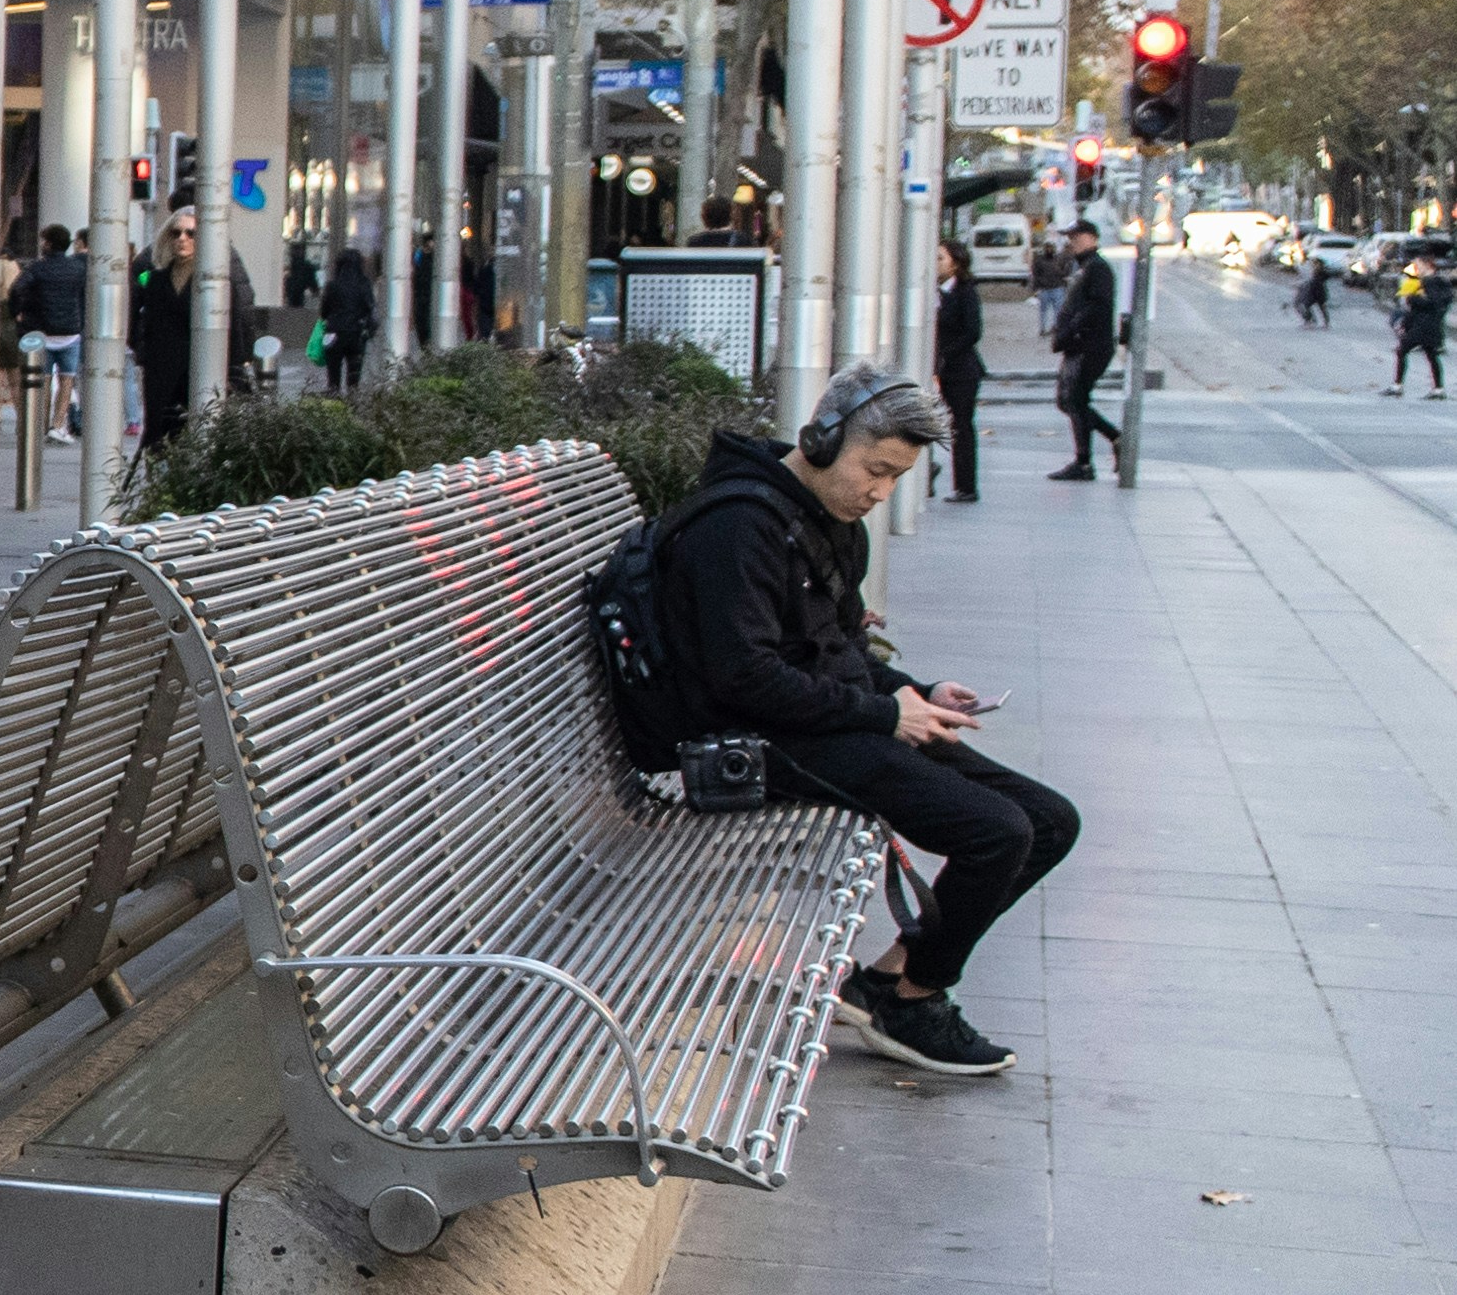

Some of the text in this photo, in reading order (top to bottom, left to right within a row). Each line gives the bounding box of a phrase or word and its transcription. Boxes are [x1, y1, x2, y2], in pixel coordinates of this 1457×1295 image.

[1015, 38, 1057, 58] WAY
[995, 67, 1021, 87] TO
[959, 95, 1055, 116] PEDESTRIANS
